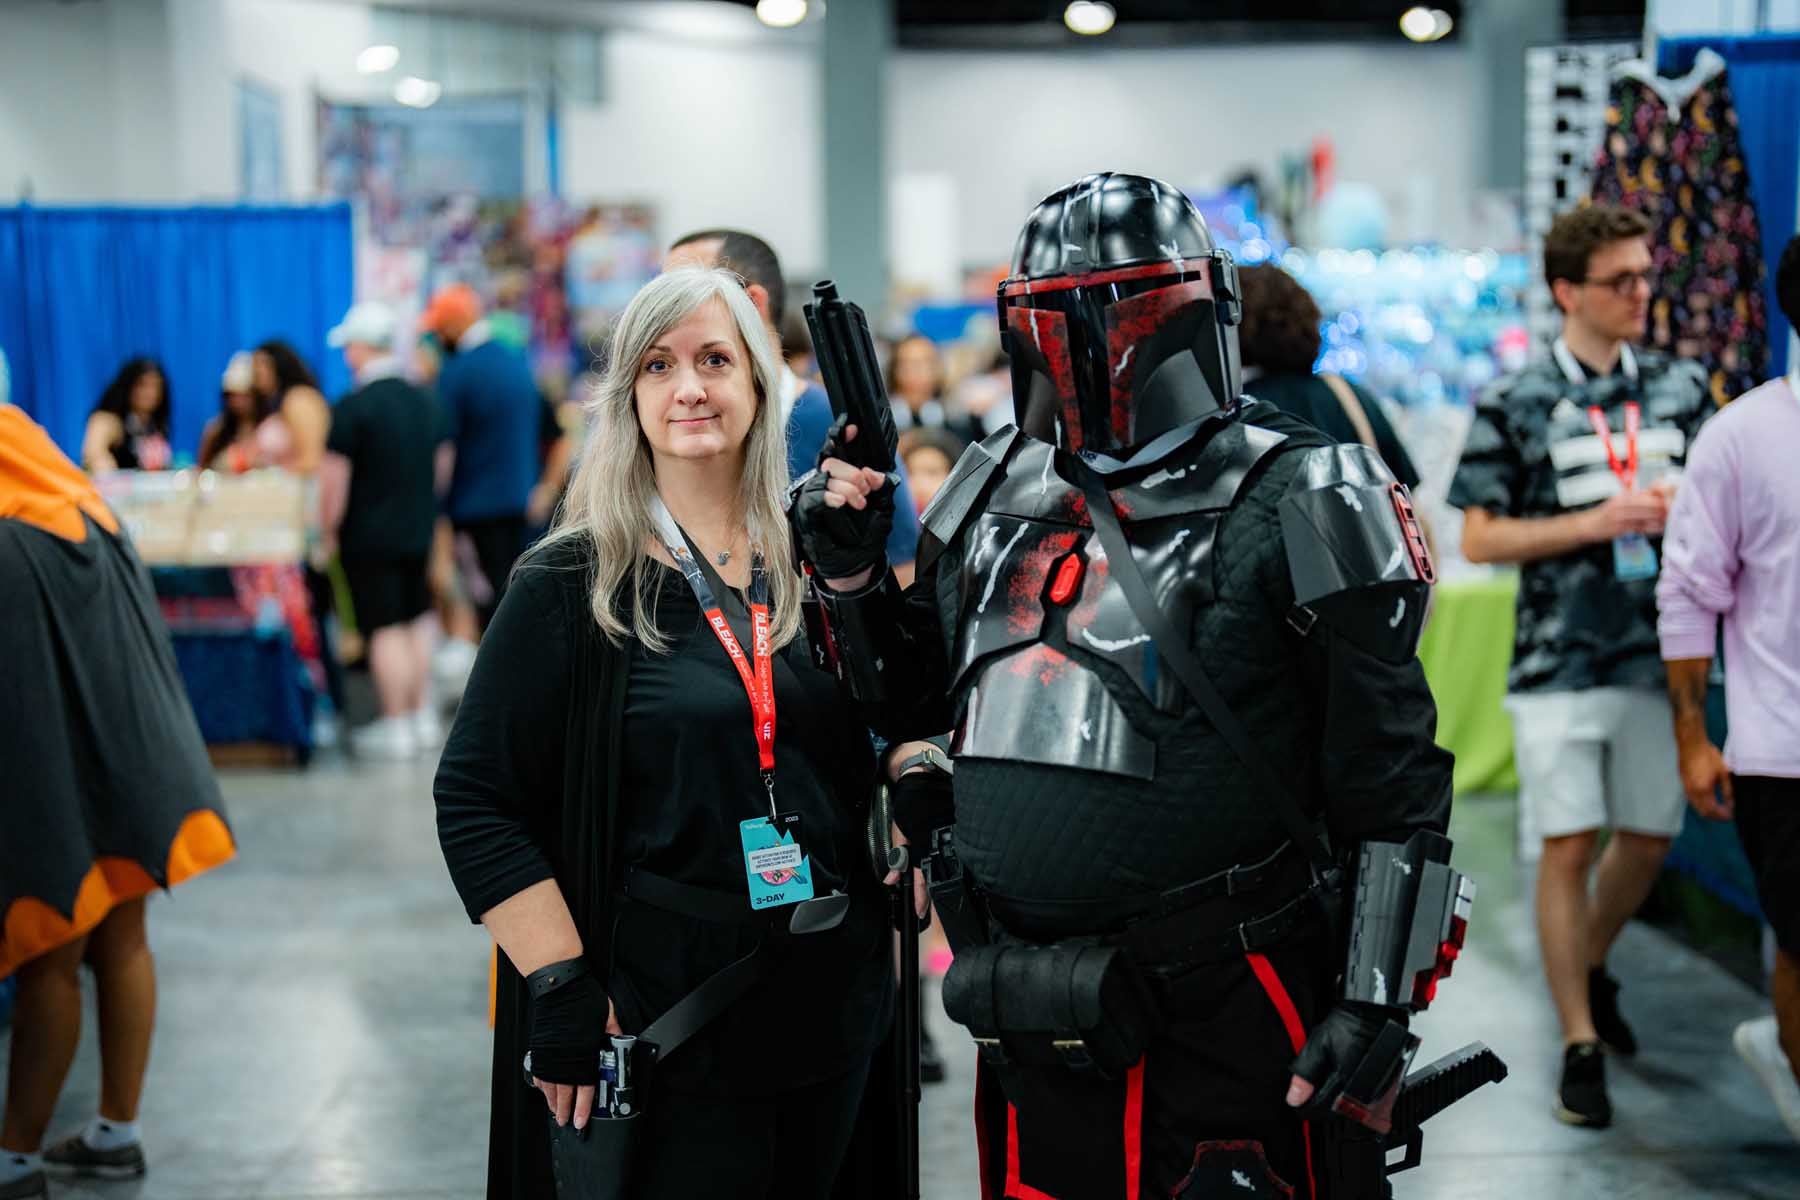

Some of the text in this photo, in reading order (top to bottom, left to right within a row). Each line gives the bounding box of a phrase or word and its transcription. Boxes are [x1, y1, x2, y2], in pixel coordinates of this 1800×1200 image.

[712, 616, 742, 659] BLEACH
[755, 612, 769, 657] BLEACH
[763, 721, 772, 741] VIZ
[756, 893, 785, 905] 3-DAY
